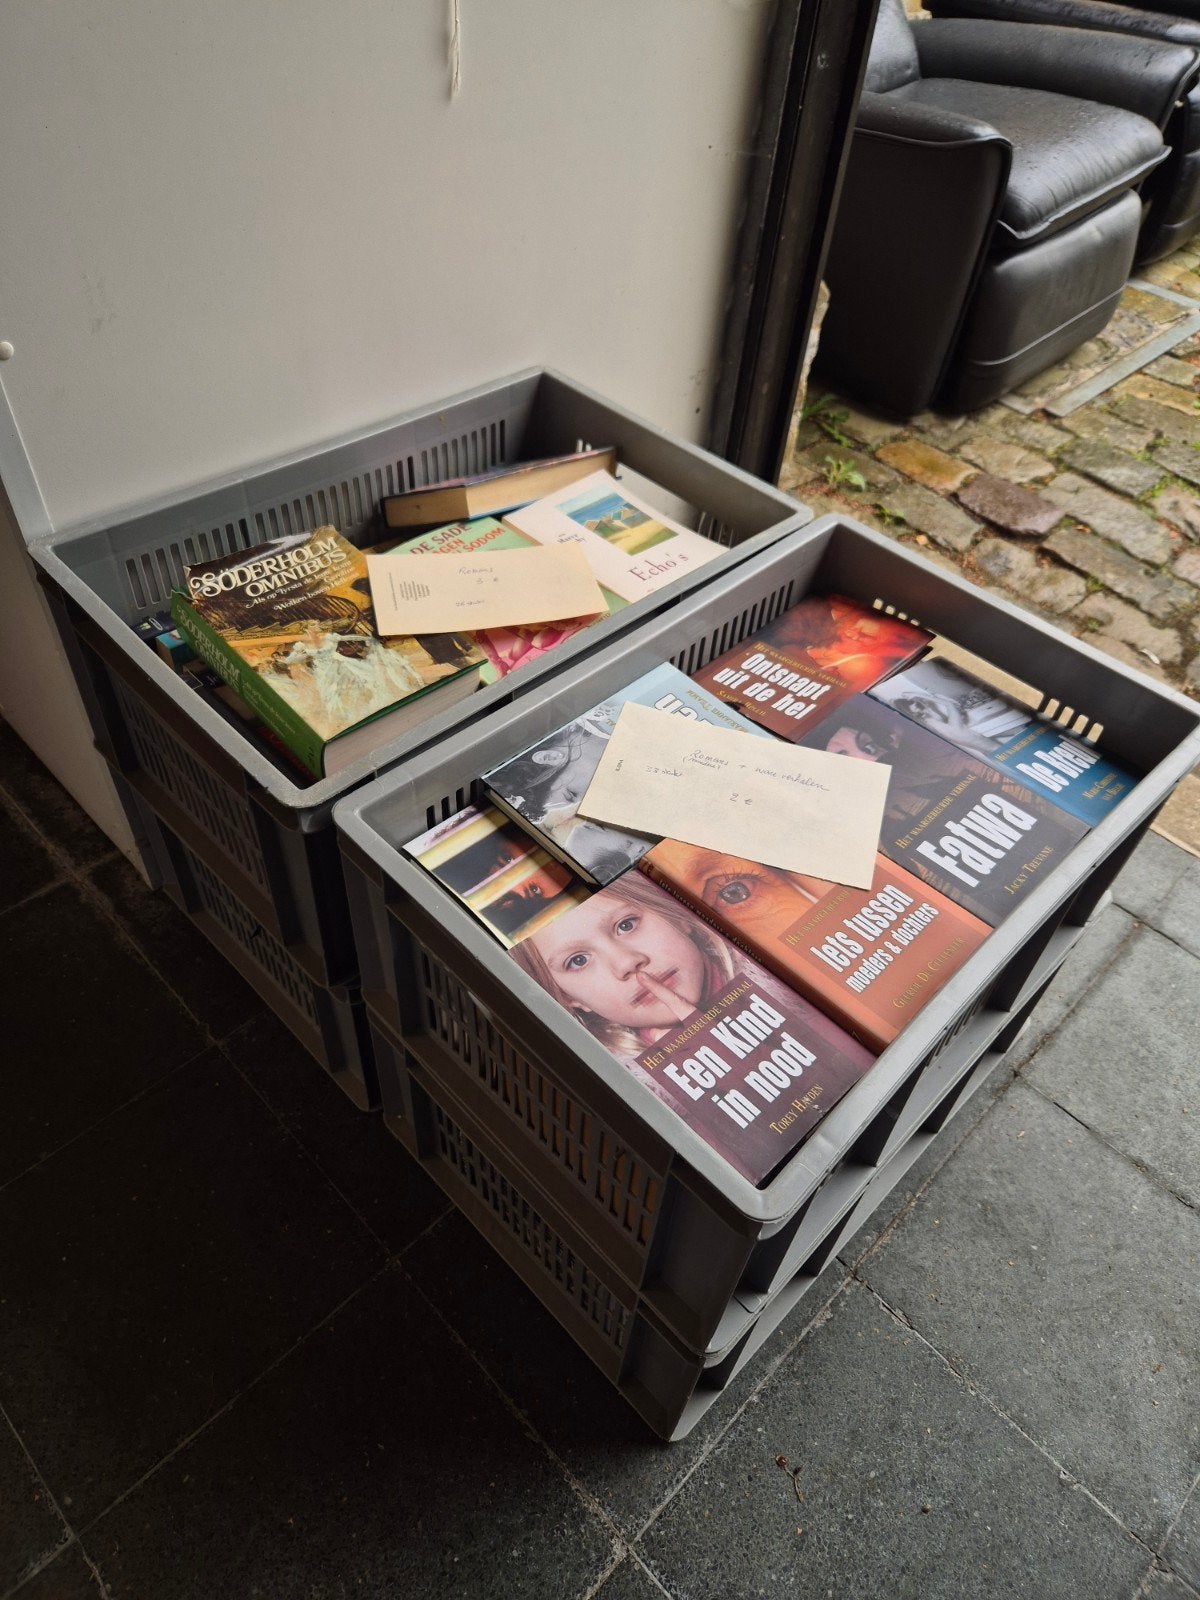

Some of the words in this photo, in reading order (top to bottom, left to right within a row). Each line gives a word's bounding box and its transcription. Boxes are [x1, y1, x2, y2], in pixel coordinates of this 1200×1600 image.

[410, 541, 433, 554] DE
[431, 523, 471, 545] SADE
[432, 538, 465, 554] GEN
[463, 527, 505, 552] SODOM
[189, 536, 338, 598] SÖDERHOLM
[245, 549, 347, 597] OMNIBUS
[628, 553, 689, 581] Echo's
[246, 594, 266, 609] Als
[266, 592, 277, 600] op
[274, 593, 306, 611] Wolken
[308, 585, 330, 598] boven
[712, 667, 751, 690] uit
[742, 682, 777, 702] de
[771, 693, 817, 720] hel
[741, 653, 831, 701] Ontsnapt
[730, 793, 739, 802] 2
[1016, 762, 1070, 793] De
[895, 836, 912, 849] HET
[911, 796, 954, 836] WAARGEBEURDE
[949, 773, 978, 799] VERHAAL
[916, 793, 1038, 888] Fatwa
[1004, 869, 1029, 895] JACKY
[1022, 844, 1054, 873] TREVANE
[809, 931, 864, 973] Iets
[842, 884, 914, 942] tussen
[891, 902, 940, 947] dochters
[845, 948, 895, 994] moeders
[883, 941, 903, 955] &
[642, 1053, 665, 1071] HET
[663, 1005, 722, 1058] WAARGEBEURDE
[719, 980, 752, 1009] VERHAAL
[662, 1045, 733, 1101] Een
[709, 993, 787, 1060] Kind
[711, 1088, 762, 1130] in
[743, 1031, 818, 1103] nood
[769, 1111, 799, 1136] TOREY
